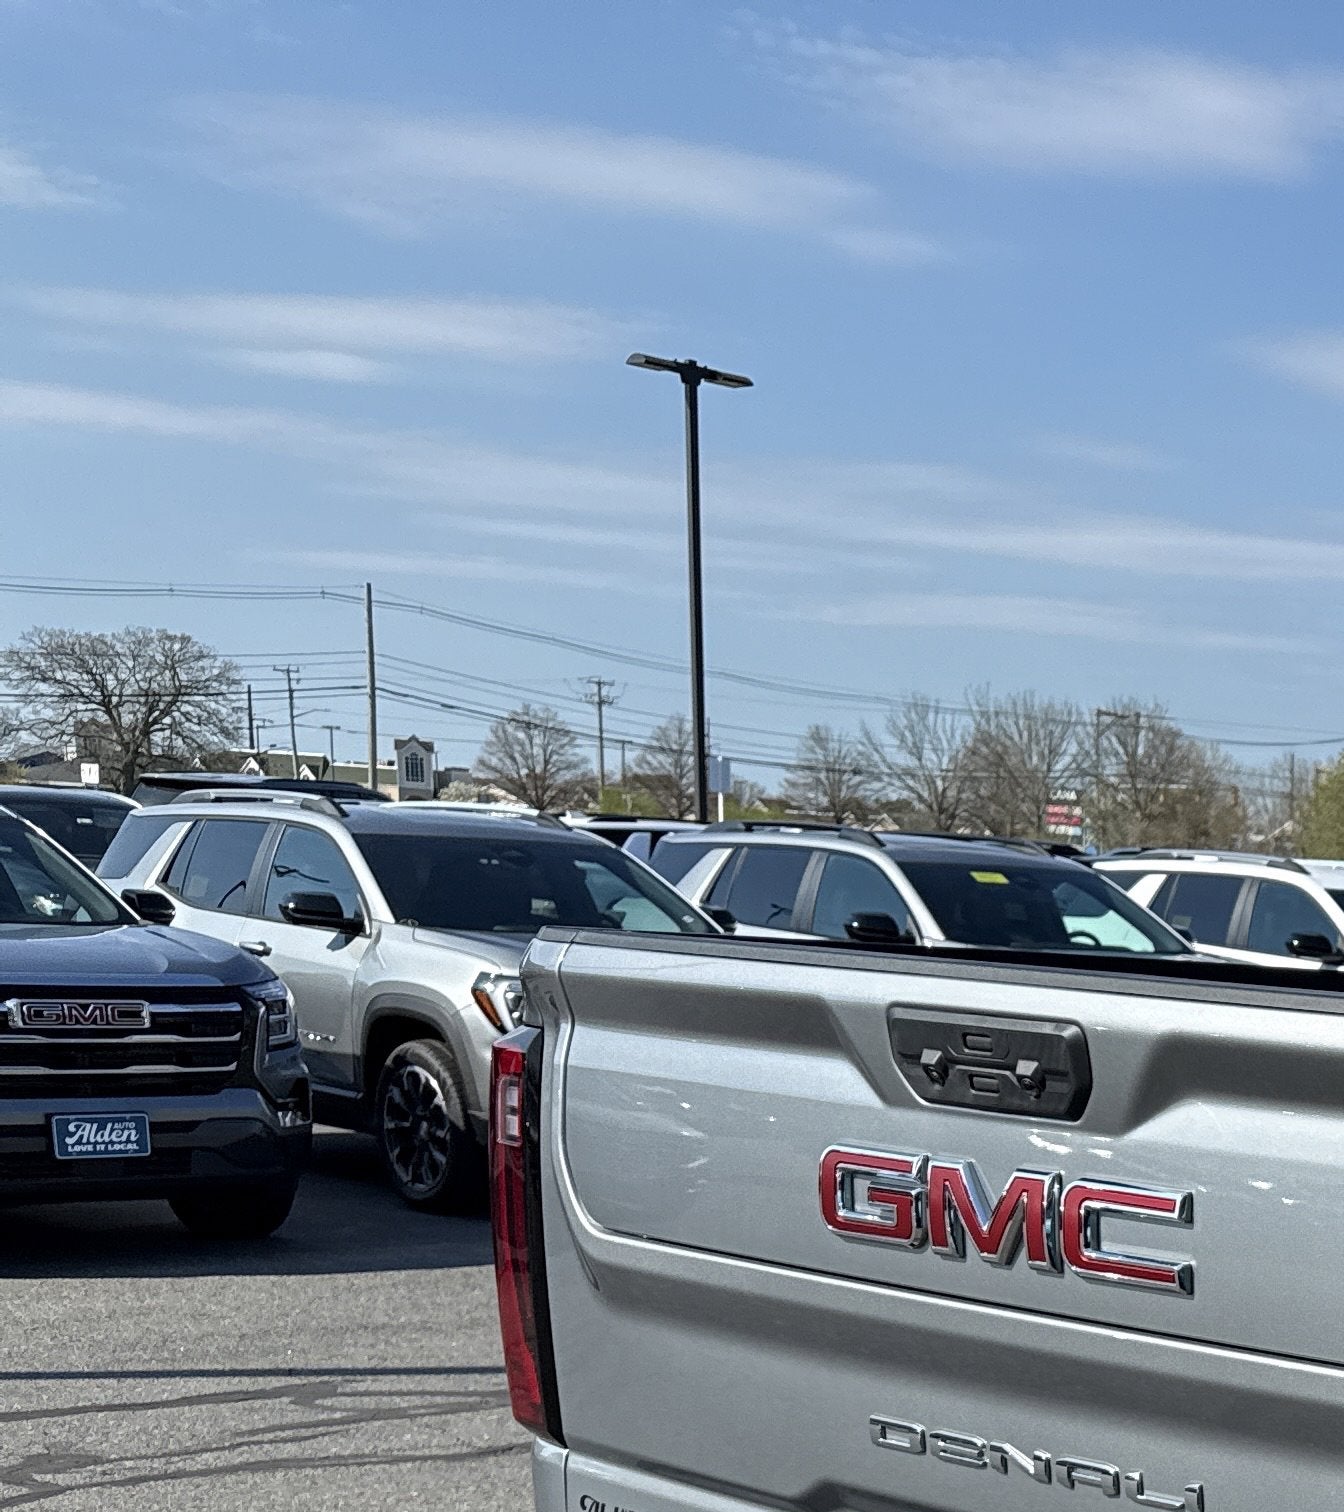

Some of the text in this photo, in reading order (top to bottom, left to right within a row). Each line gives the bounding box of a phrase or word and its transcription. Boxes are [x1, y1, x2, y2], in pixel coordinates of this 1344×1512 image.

[22, 1003, 145, 1025] GMC
[65, 1121, 139, 1144] Alden
[68, 1144, 94, 1152] LOVE
[108, 1143, 139, 1151] LOCAL
[819, 1143, 1194, 1299] GMC
